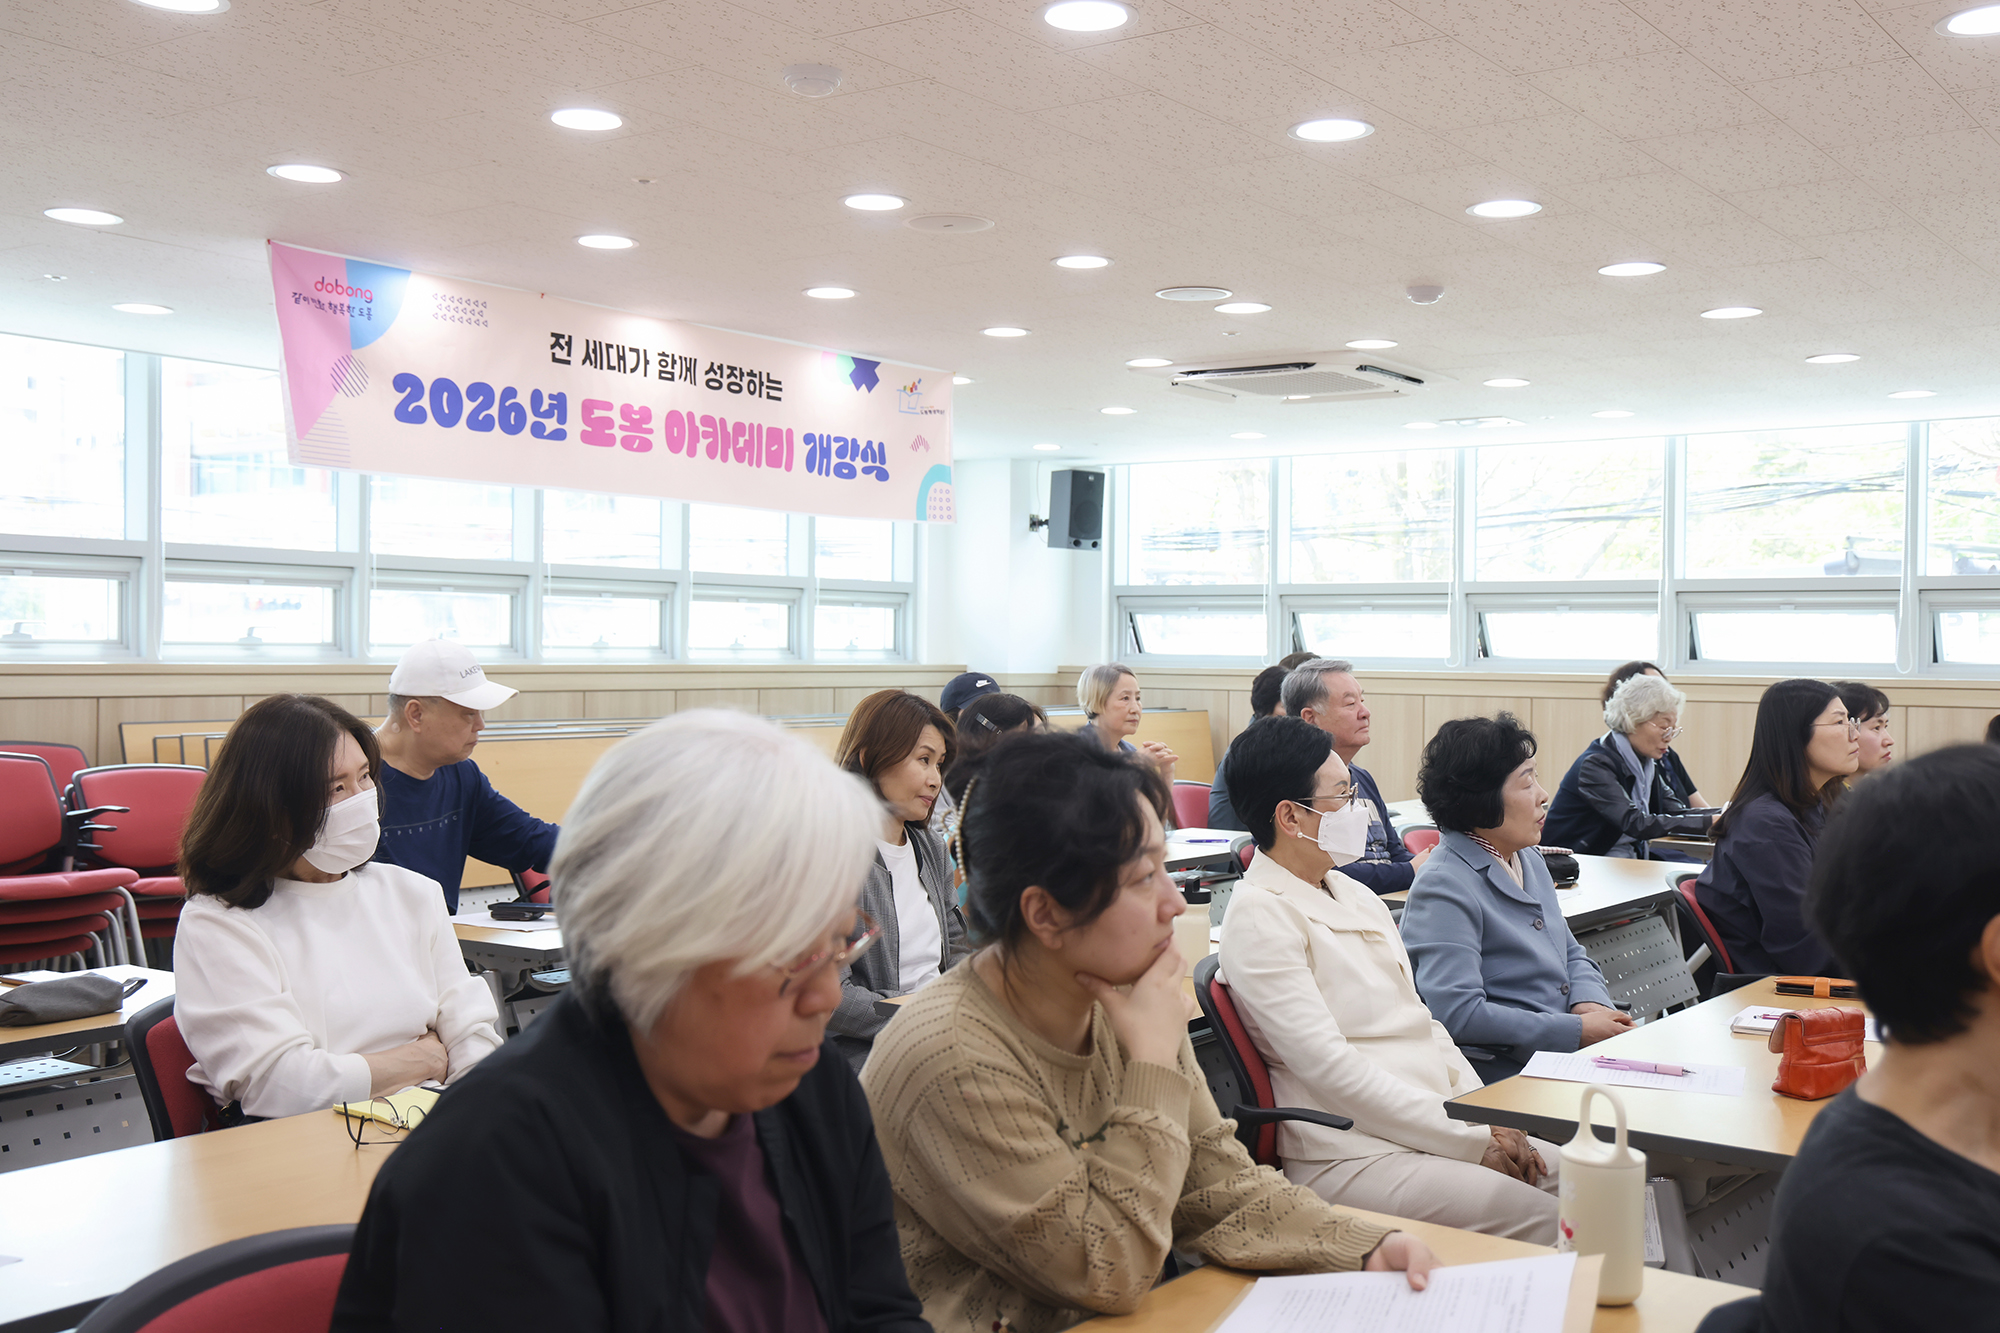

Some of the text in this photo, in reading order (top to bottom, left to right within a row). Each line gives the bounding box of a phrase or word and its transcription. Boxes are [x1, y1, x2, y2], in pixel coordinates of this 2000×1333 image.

[314, 276, 373, 303] dobong
[328, 301, 355, 318] 행복한
[358, 307, 372, 321] 도봉
[550, 332, 783, 402] 전 세대가 함께 성장하는
[392, 372, 890, 482] 2026년 도봉 아카데미 개강식
